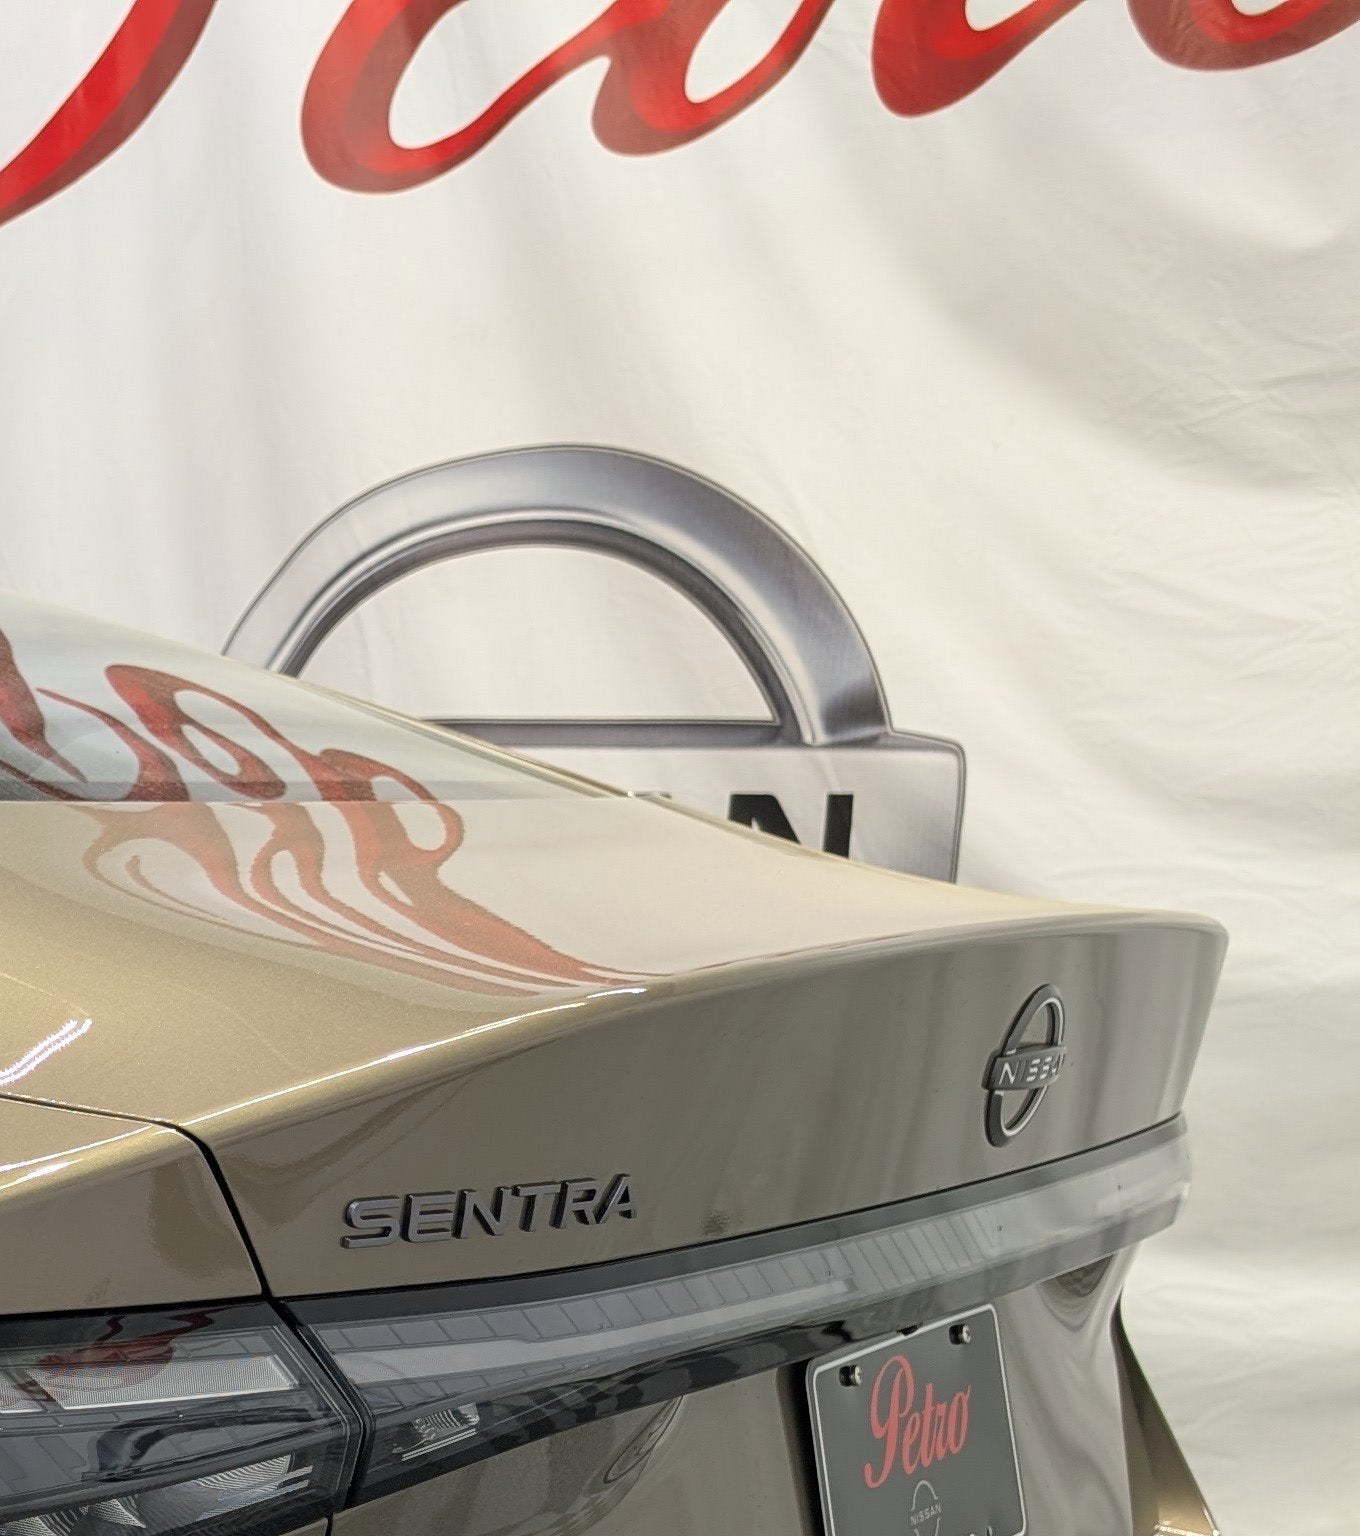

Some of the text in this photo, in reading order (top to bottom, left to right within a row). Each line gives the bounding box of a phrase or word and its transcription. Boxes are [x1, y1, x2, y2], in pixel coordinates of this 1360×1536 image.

[341, 1173, 637, 1249] SENTRA
[864, 1355, 972, 1489] Petro
[910, 1503, 942, 1526] NISSAN
